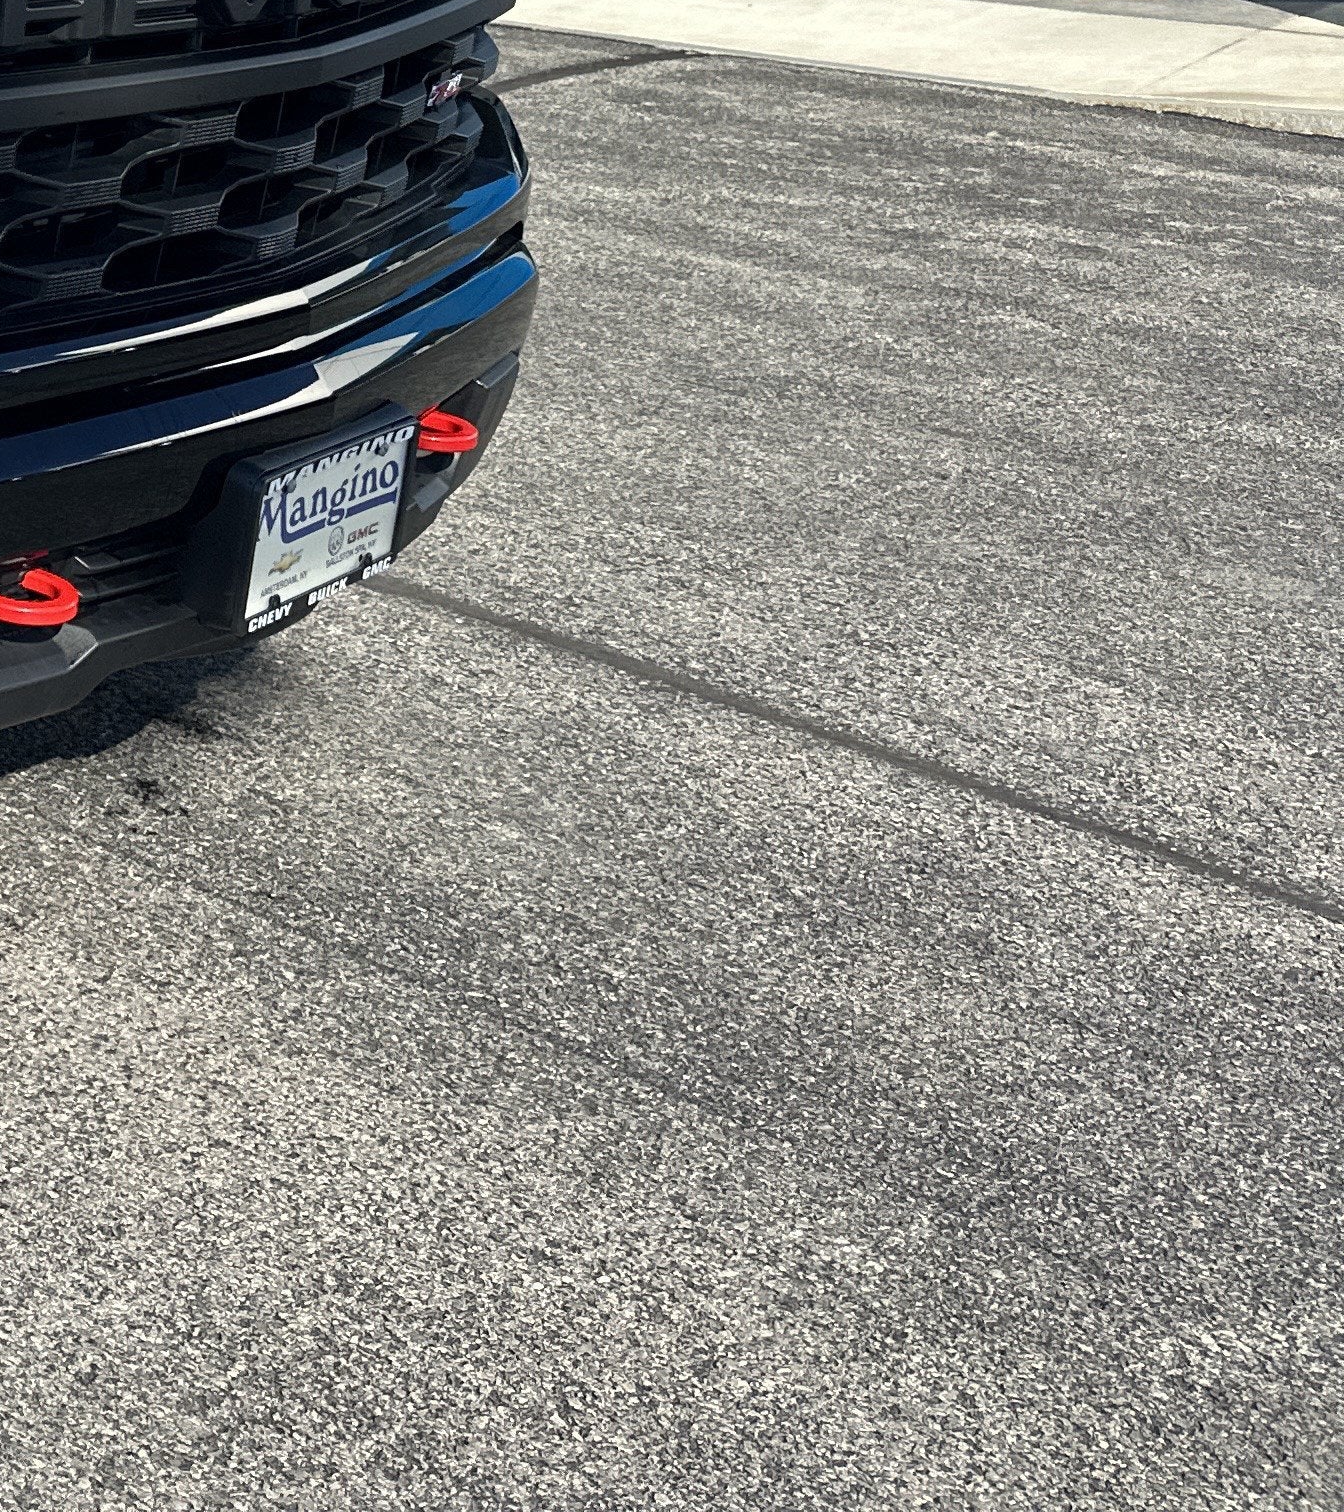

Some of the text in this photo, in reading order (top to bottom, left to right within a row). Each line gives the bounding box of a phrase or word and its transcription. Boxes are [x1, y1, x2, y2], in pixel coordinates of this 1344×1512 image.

[267, 425, 415, 496] MANGINO
[262, 460, 400, 544] Mangino
[347, 521, 380, 544] GMC
[248, 556, 392, 633] CHEVY BUICK GMC
